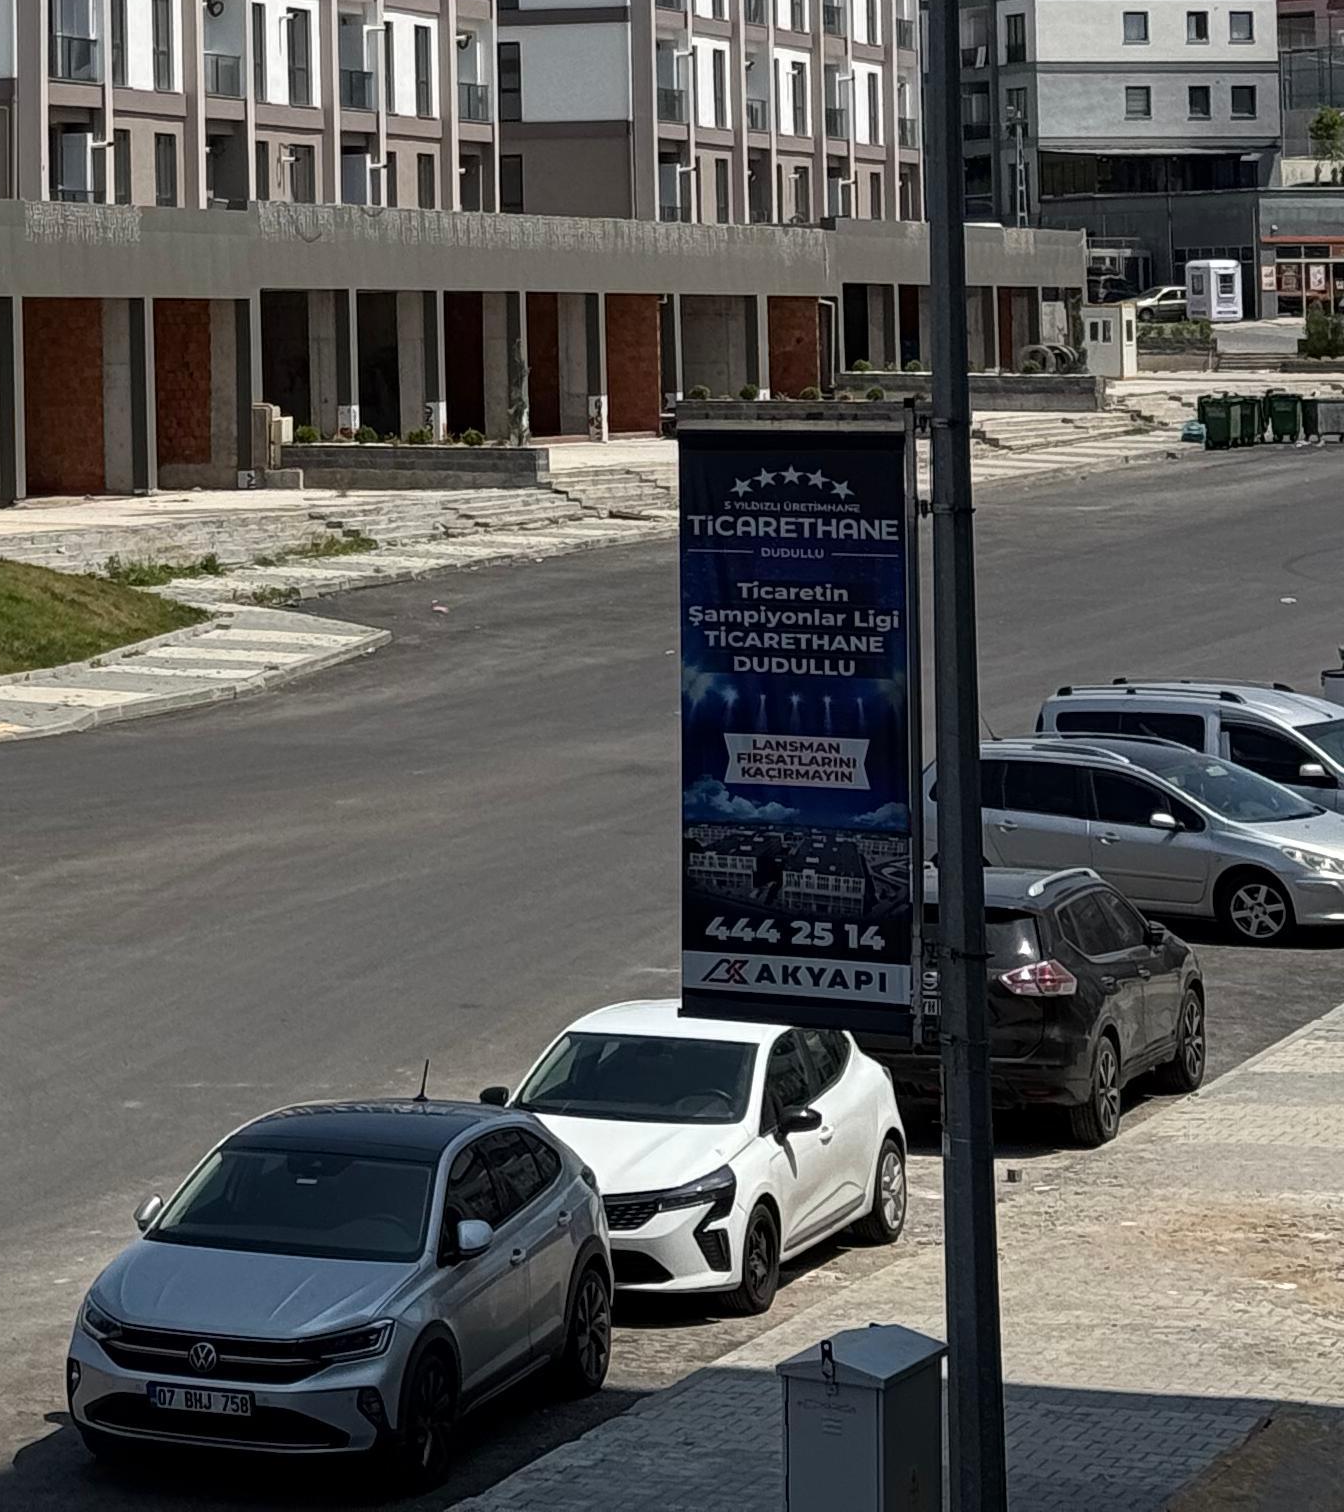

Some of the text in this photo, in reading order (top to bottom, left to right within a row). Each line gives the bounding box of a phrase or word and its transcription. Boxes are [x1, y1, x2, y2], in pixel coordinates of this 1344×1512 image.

[724, 500, 861, 513] 5 YILDIZLI ÜRETİMHANE
[761, 547, 825, 559] DUDULLU
[737, 581, 849, 602] Ticaretin
[688, 605, 899, 632] Şampiyonlar Ligi
[704, 626, 884, 653] TİCARETHANE
[733, 656, 856, 677] DUDULLU
[753, 739, 841, 755] LANSMAN
[737, 752, 857, 769] FIRSATLARINI
[741, 766, 853, 783] KAÇIRMAYIN
[705, 916, 886, 951] 444 25 14
[754, 963, 887, 993] AKYAPI
[158, 1389, 249, 1414] 07 BHJ 758
